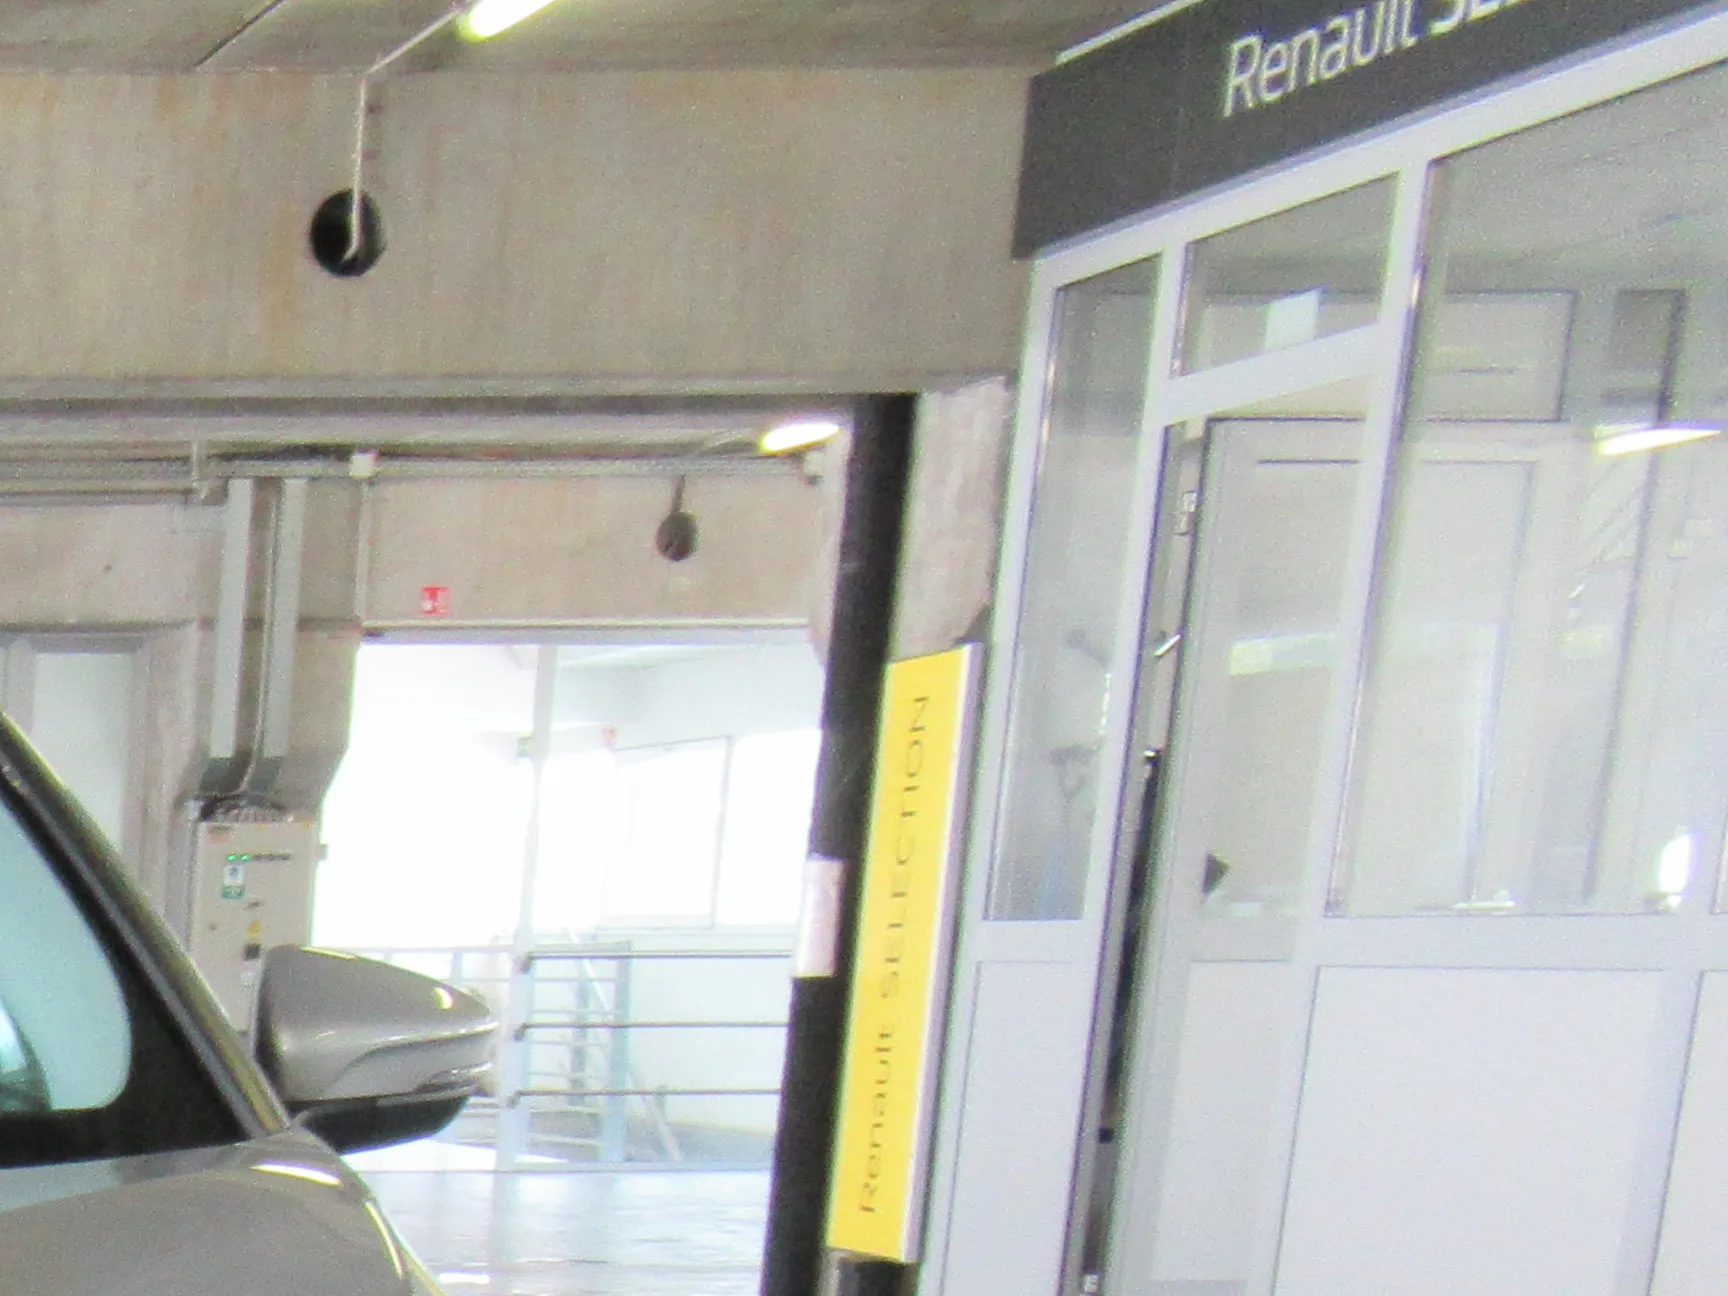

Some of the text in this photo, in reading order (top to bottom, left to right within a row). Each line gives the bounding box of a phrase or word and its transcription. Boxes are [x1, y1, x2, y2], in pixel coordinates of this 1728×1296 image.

[1223, 0, 1420, 117] Renault
[858, 695, 931, 1213] Renault SELECTION
